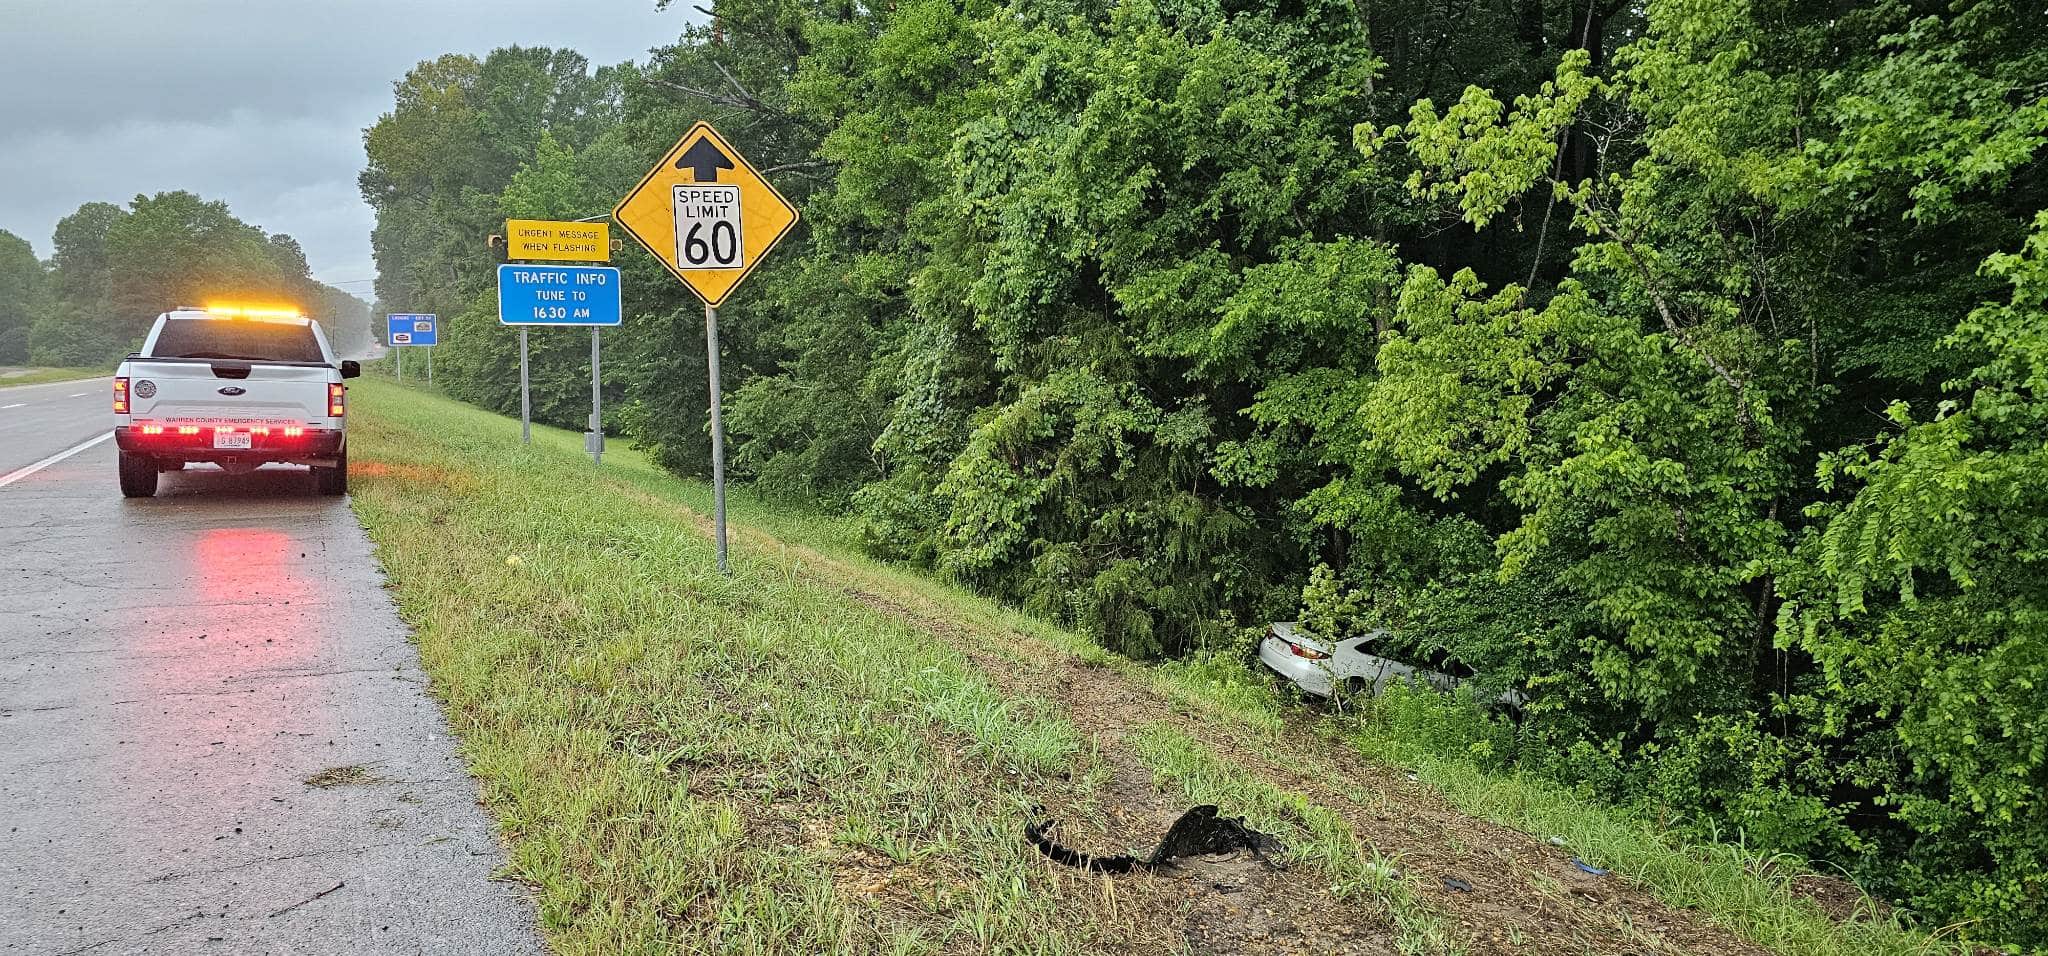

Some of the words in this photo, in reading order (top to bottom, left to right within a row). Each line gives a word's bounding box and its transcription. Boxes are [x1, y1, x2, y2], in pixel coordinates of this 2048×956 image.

[679, 190, 734, 203] SPEED
[686, 205, 728, 218] LIMIT
[518, 229, 552, 238] URGENT
[559, 231, 599, 240] MESSAGE
[522, 243, 548, 251] WHEN
[553, 244, 596, 252] FLASHING
[685, 220, 737, 265] 60
[513, 271, 568, 284] TRAFFIC
[576, 273, 606, 286] INFO
[535, 290, 566, 301] TUNE
[571, 291, 586, 301] TO
[533, 306, 566, 319] 1630
[573, 308, 590, 318] AM
